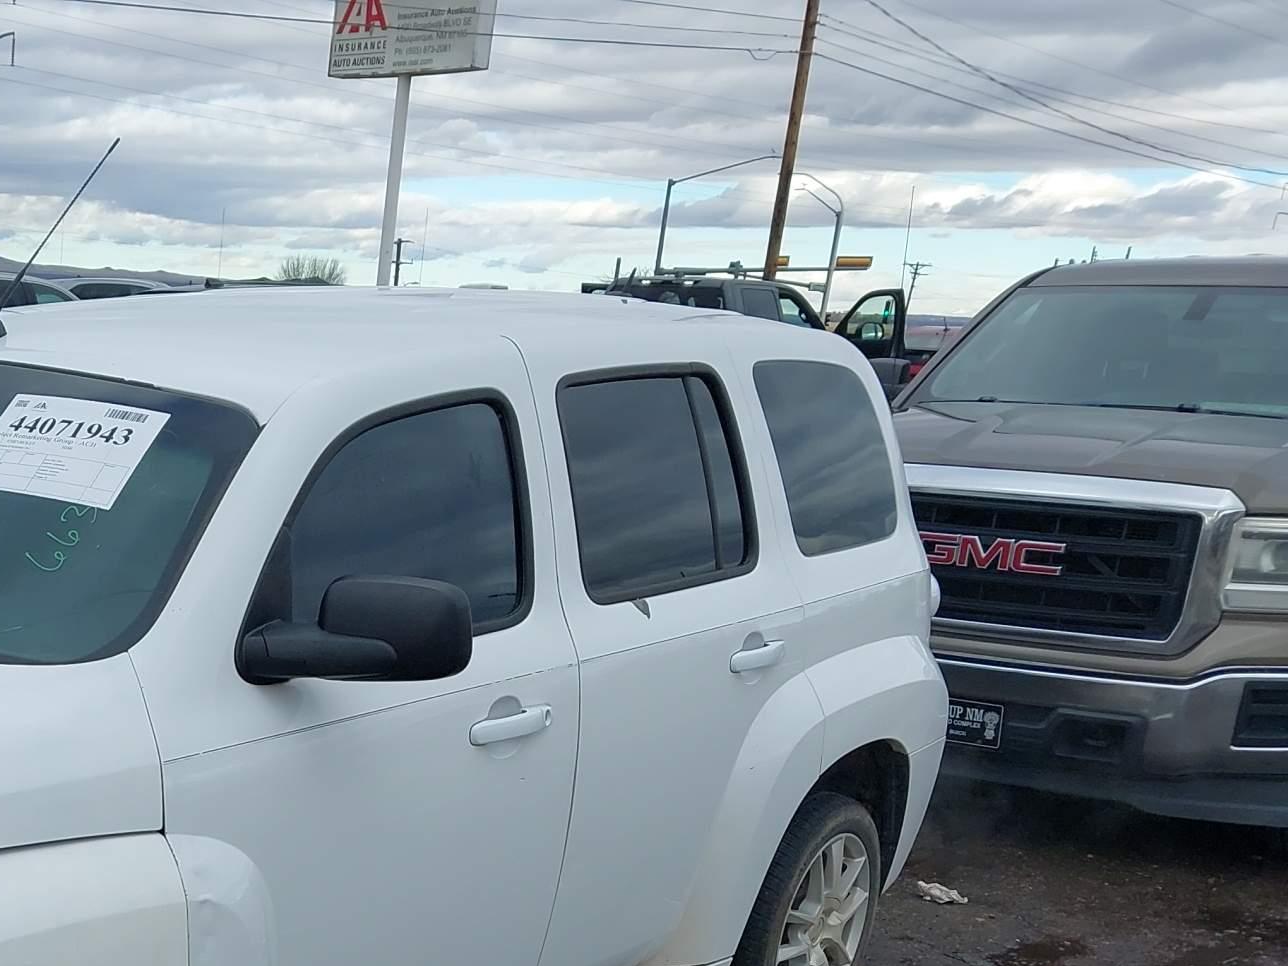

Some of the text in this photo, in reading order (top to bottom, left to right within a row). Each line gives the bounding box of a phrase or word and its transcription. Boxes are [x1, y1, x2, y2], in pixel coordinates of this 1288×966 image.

[334, 40, 387, 53] INSURANCE
[332, 55, 386, 68] AUTO AUCTIONS
[9, 415, 134, 446] 44071943
[919, 531, 1067, 576] GMC
[965, 706, 985, 722] NM
[953, 719, 981, 729] COMPLEX
